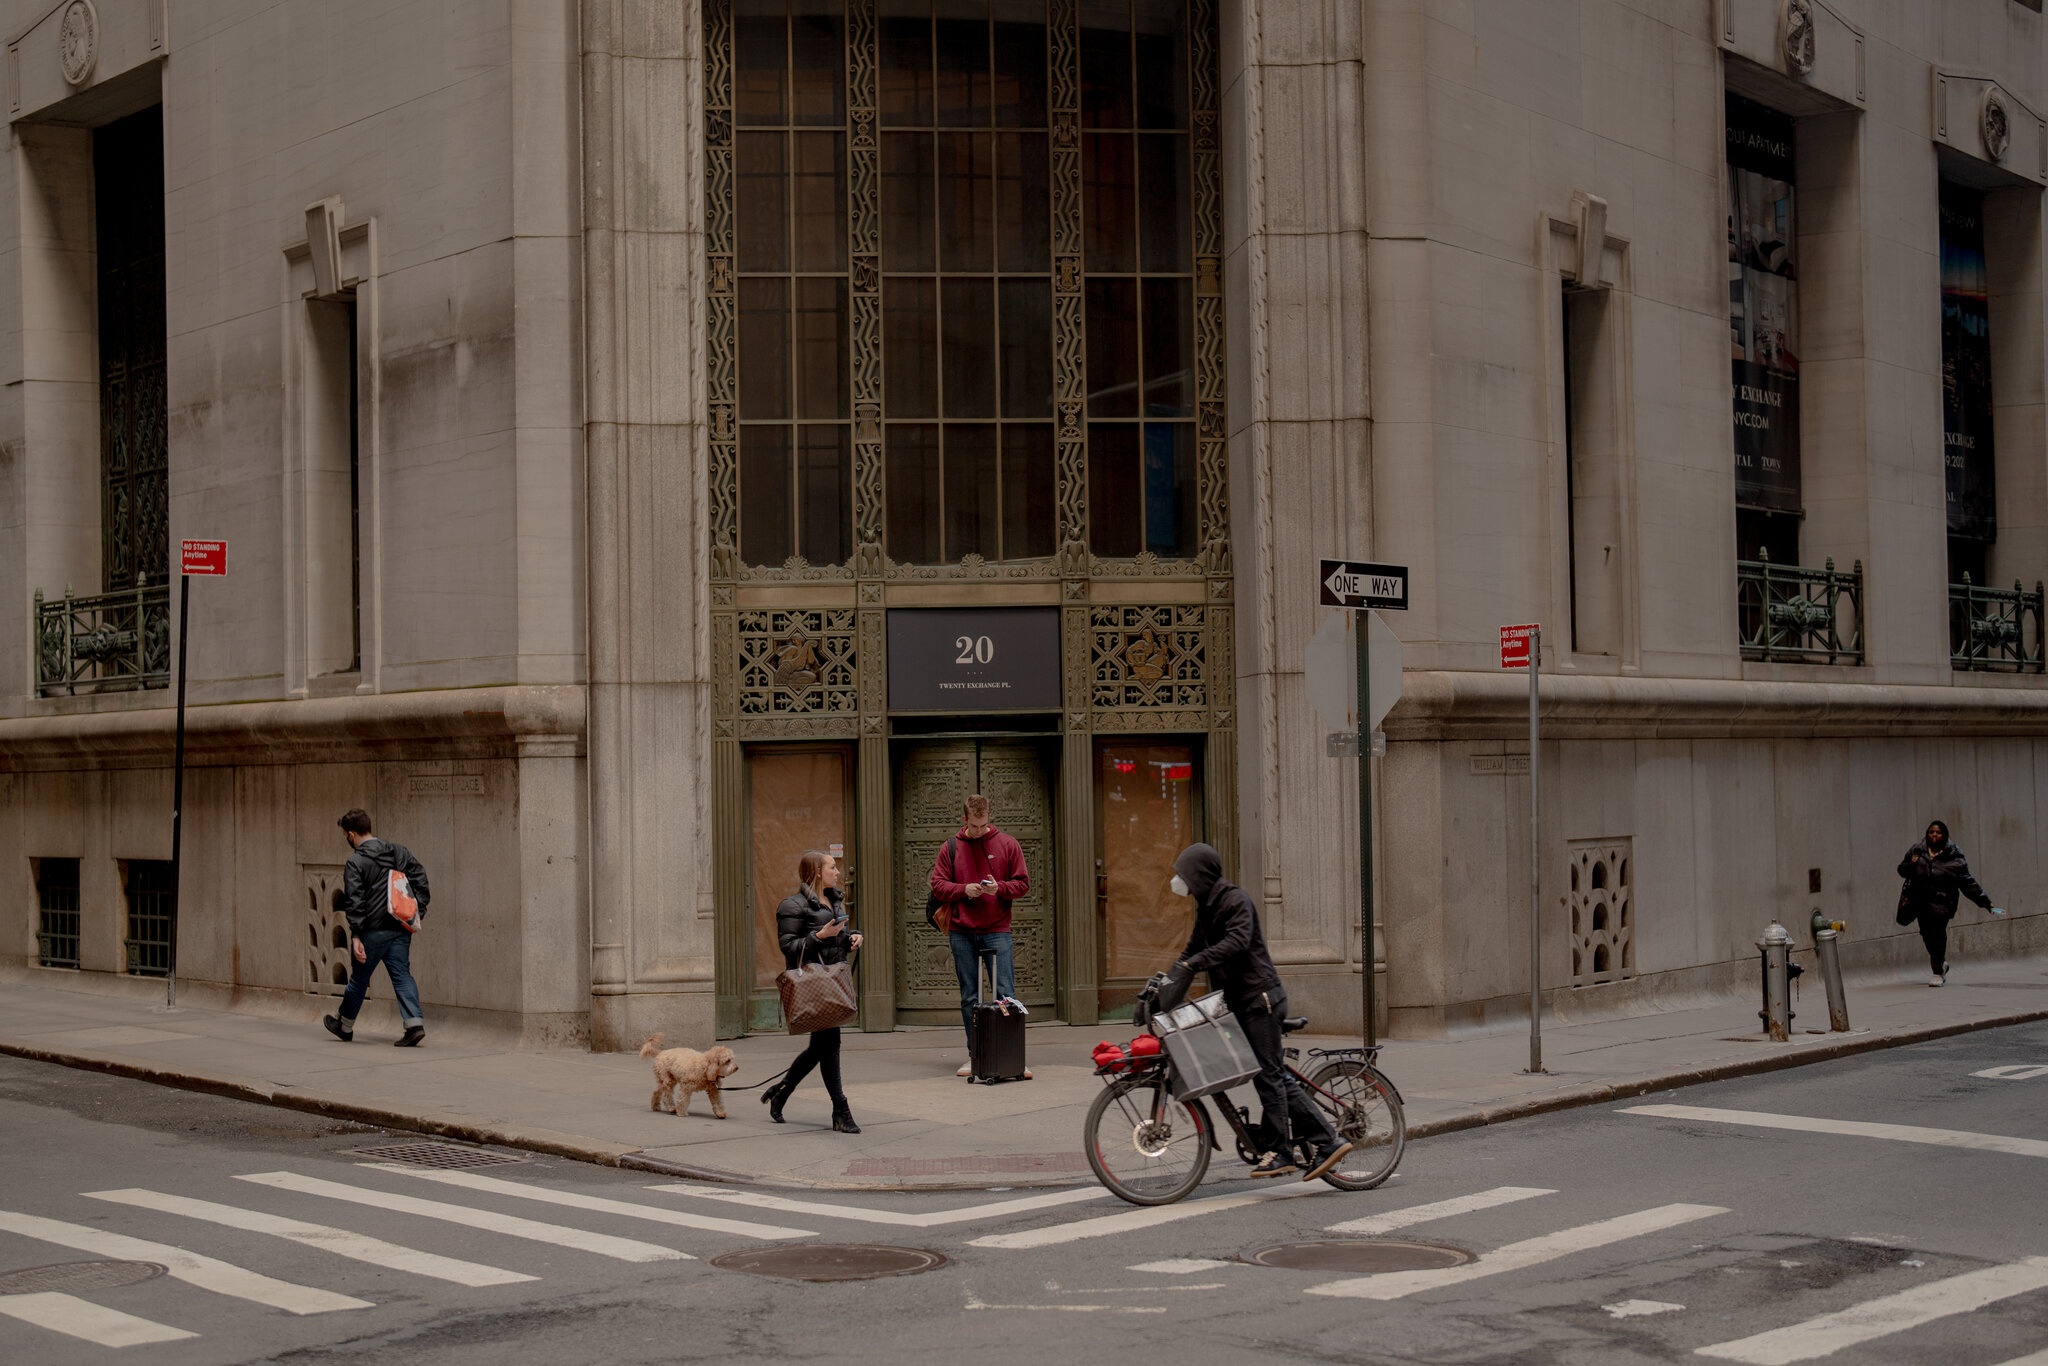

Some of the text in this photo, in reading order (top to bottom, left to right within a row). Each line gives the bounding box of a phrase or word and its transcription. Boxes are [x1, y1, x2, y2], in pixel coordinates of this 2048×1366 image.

[1741, 384, 1782, 408] EXCHANGE
[183, 543, 220, 552] NO STANDING
[184, 551, 207, 559] Anytime
[1334, 575, 1397, 596] ONE WAY
[1502, 630, 1510, 639] NO
[955, 635, 994, 664] 20
[1503, 640, 1522, 649] Anytime
[409, 778, 448, 792] EXCHANGE
